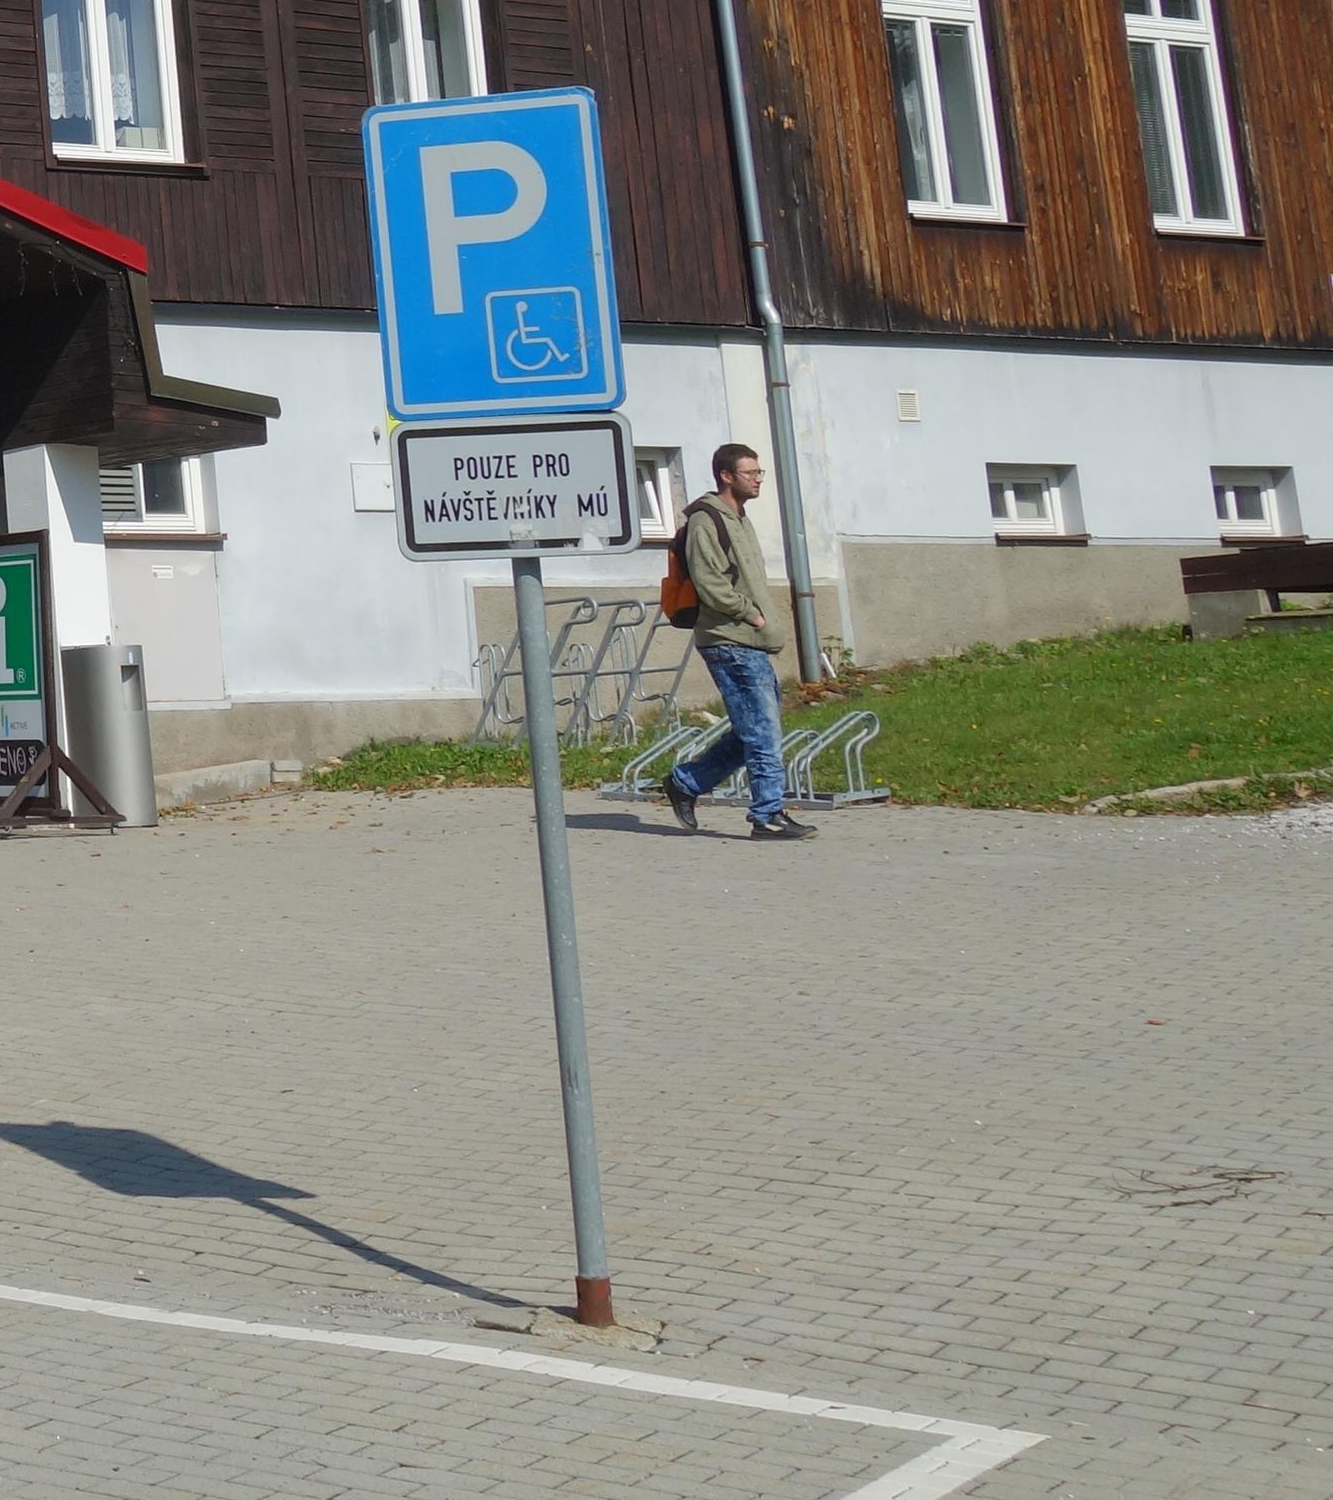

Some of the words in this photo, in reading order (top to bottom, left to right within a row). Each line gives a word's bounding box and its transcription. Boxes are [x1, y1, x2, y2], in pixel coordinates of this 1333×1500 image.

[420, 140, 548, 315] P
[453, 454, 518, 481] POUZE
[532, 453, 571, 478] PRO
[577, 485, 609, 518] MÚ
